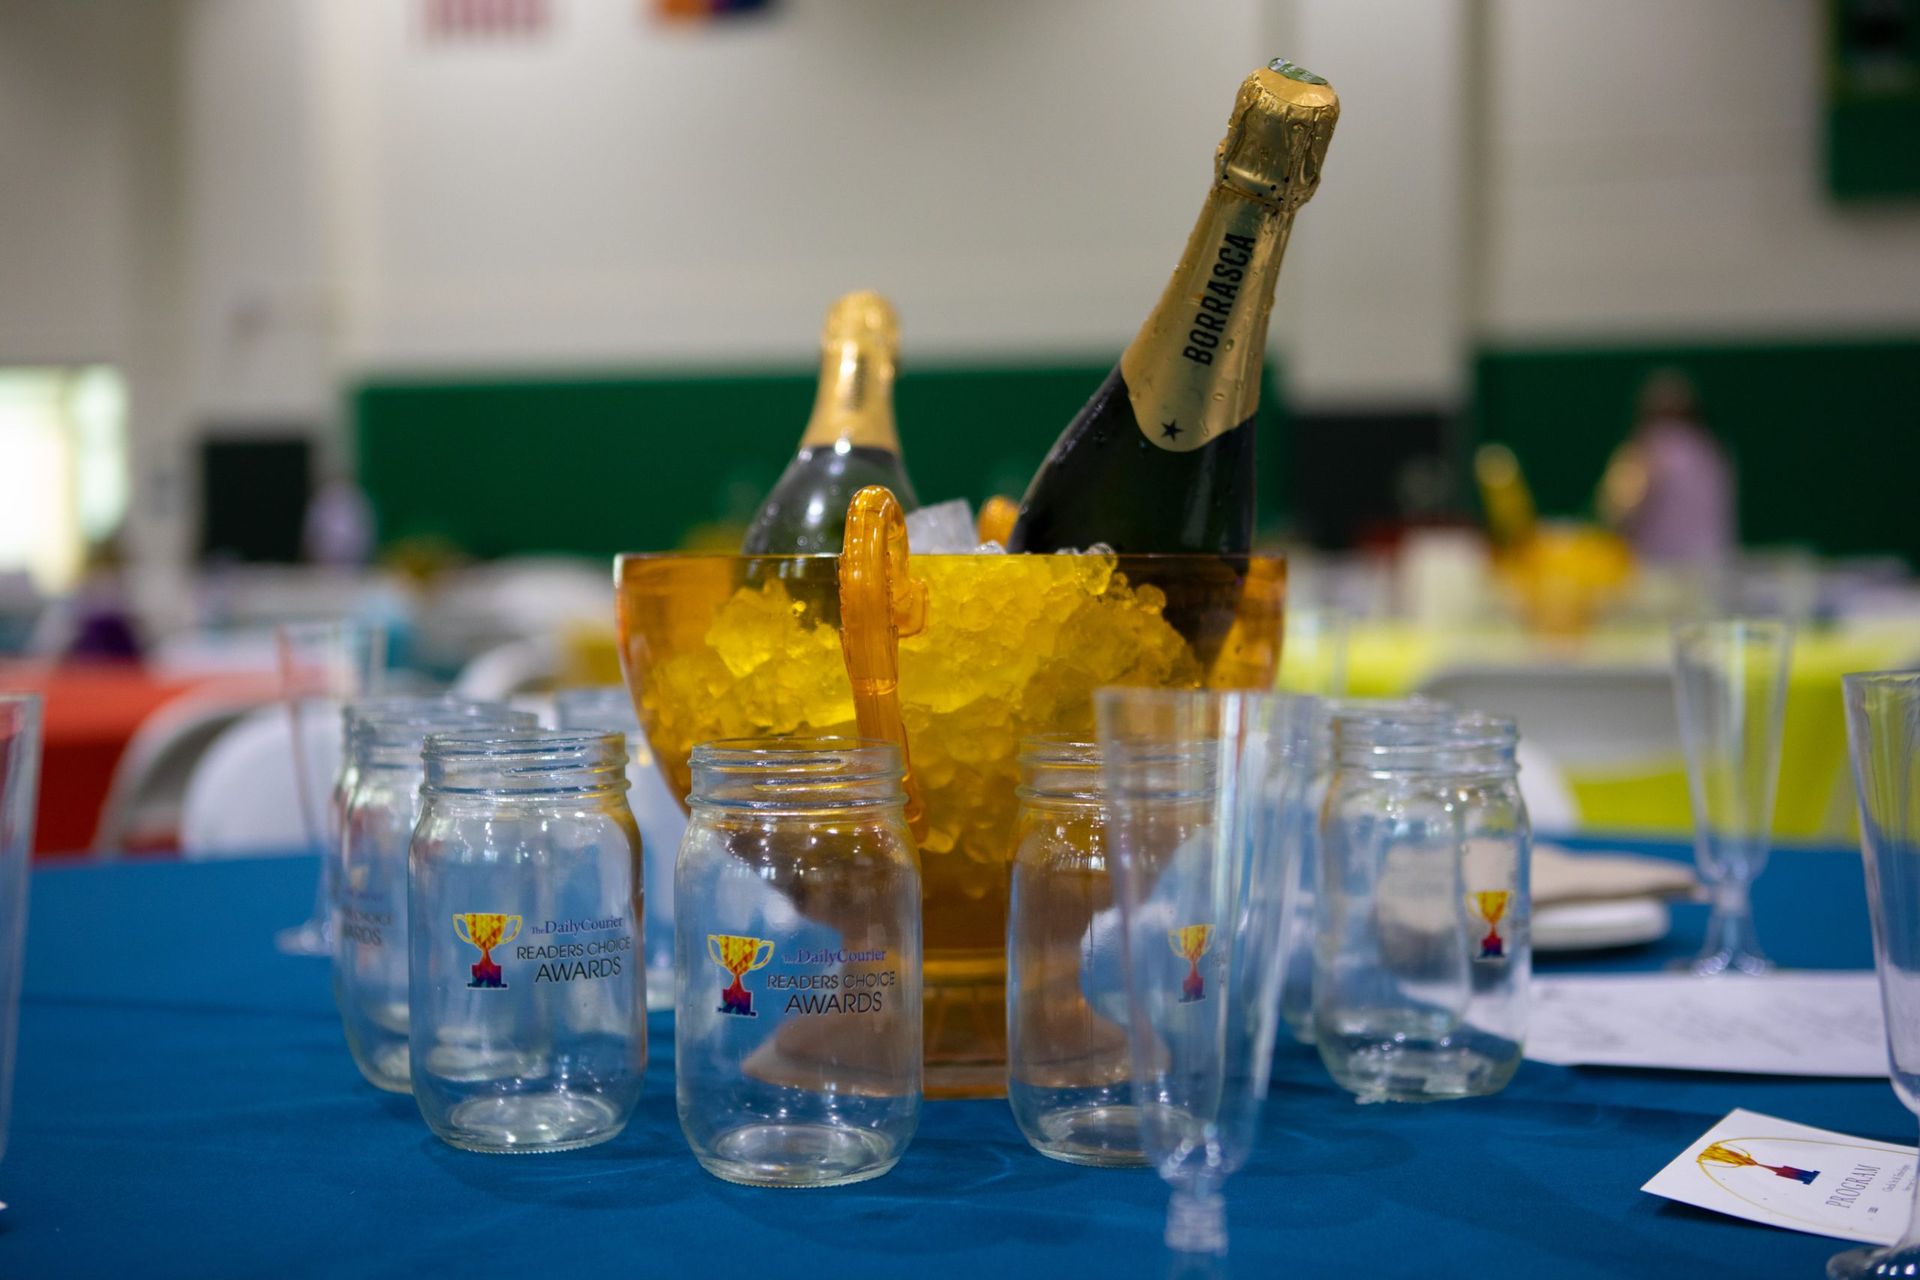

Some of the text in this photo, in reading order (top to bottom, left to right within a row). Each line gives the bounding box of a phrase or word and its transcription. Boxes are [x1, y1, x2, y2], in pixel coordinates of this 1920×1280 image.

[1183, 233, 1256, 366] BORRASCA
[517, 936, 631, 960] READERS CHOICE
[535, 956, 622, 983] AWARDS
[767, 971, 895, 990] READERS CHOICE
[784, 991, 883, 1014] AWARDS
[1825, 1164, 1881, 1209] PROGRAM
